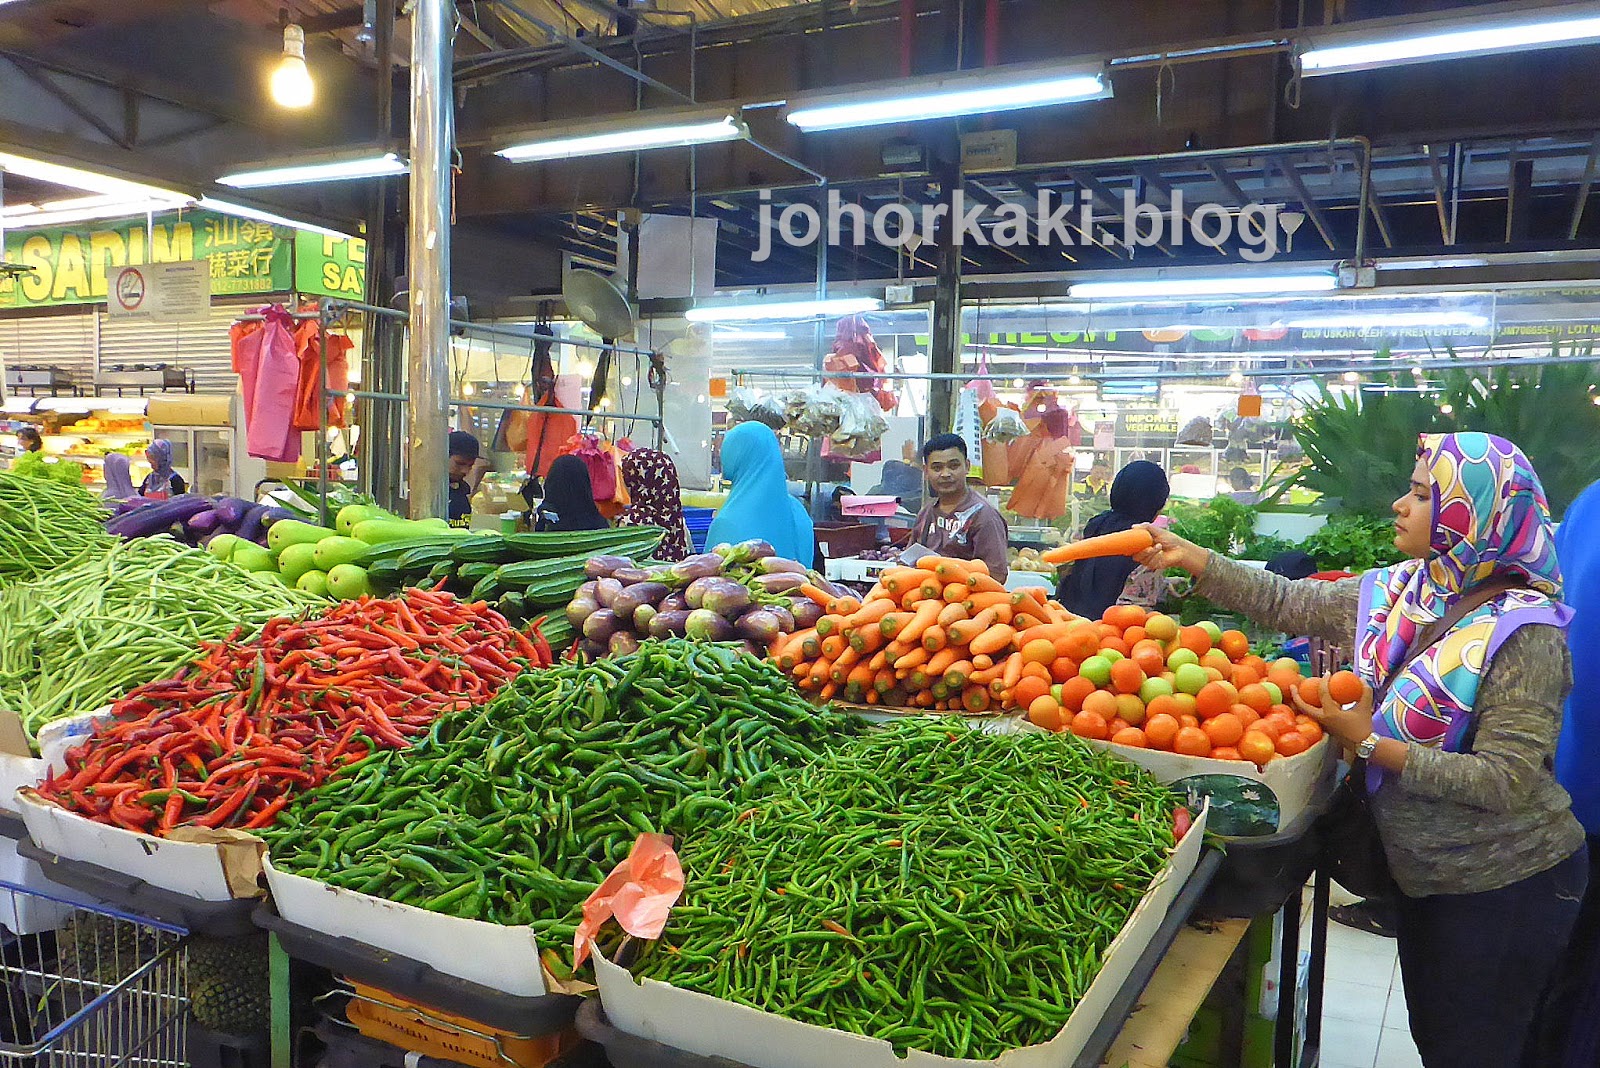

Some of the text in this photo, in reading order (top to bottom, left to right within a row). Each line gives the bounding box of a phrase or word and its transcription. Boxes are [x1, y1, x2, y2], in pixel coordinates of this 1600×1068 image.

[22, 222, 193, 300] SADIM
[205, 248, 274, 278] 蔬菜行
[323, 262, 366, 294] SA
[1567, 324, 1589, 335] LOT
[1126, 413, 1178, 423] IMPORTE
